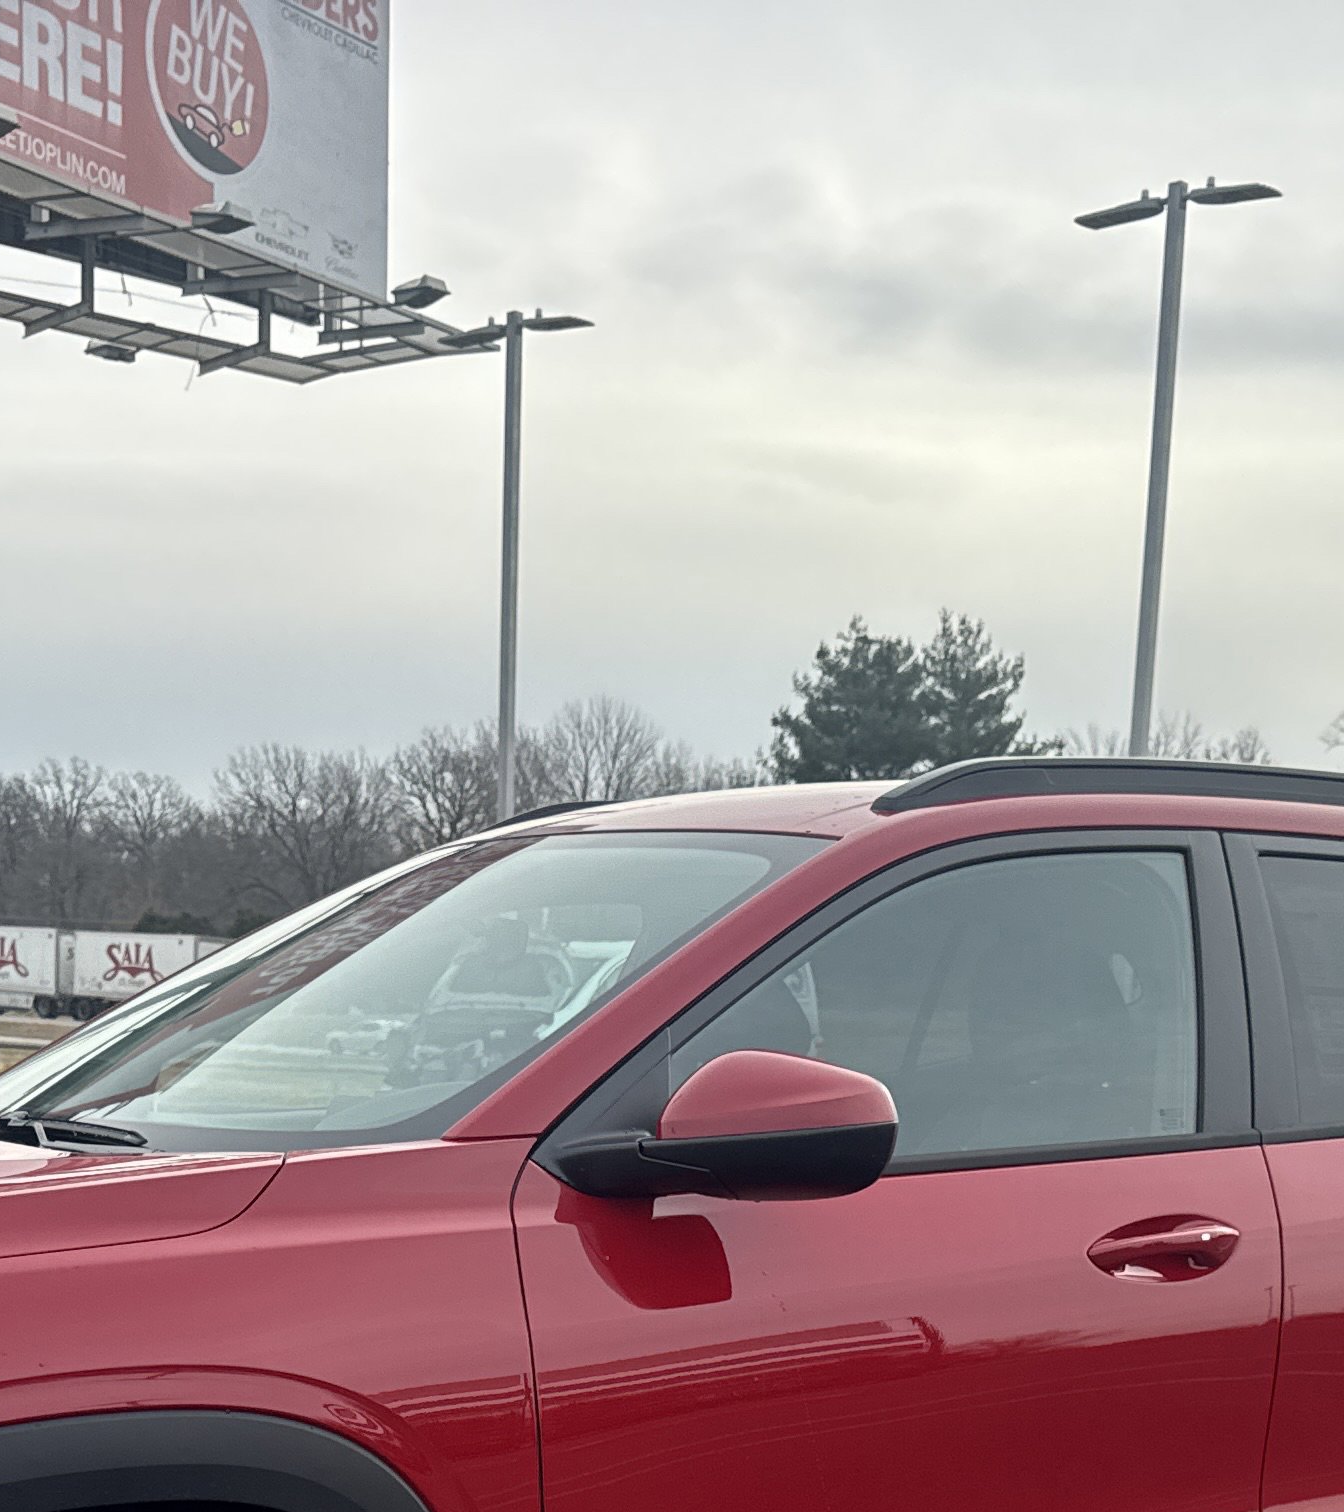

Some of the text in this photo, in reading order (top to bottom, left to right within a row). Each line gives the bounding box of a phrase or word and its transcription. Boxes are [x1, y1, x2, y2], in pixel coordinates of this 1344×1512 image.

[189, 0, 247, 74] WE
[167, 23, 255, 135] BUY!
[104, 943, 160, 977] SAIA
